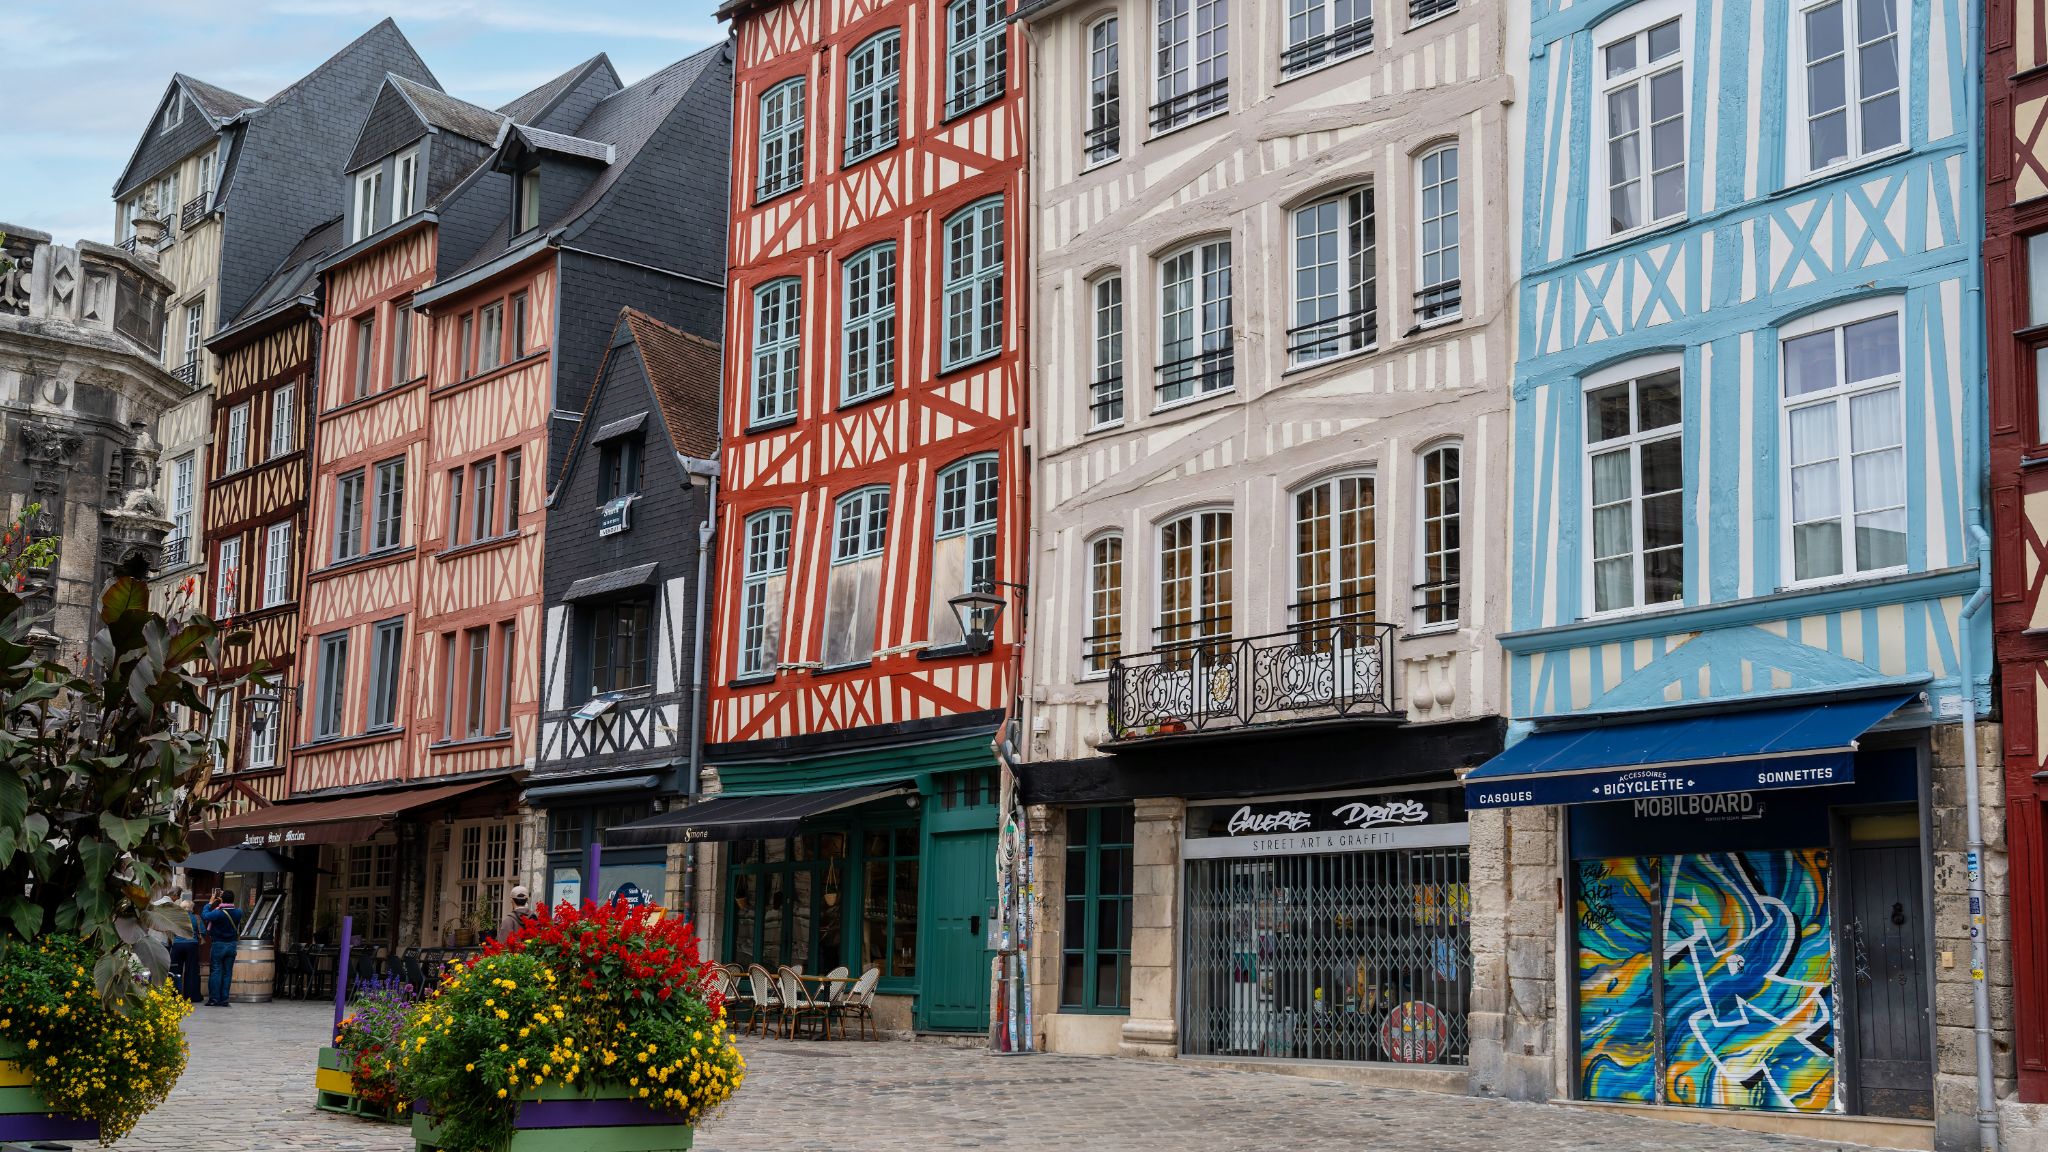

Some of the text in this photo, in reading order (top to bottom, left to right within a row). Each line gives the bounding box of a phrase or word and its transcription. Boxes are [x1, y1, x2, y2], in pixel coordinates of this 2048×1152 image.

[1619, 770, 1667, 782] ACCESSOIRES
[1758, 767, 1833, 784] SONNETTES
[1603, 778, 1684, 795] BICYCLETTE
[1479, 791, 1533, 804] CASQUES
[1634, 792, 1753, 818] MOBILBOARD
[1253, 832, 1395, 850] STREET ART & GRAFFITI
